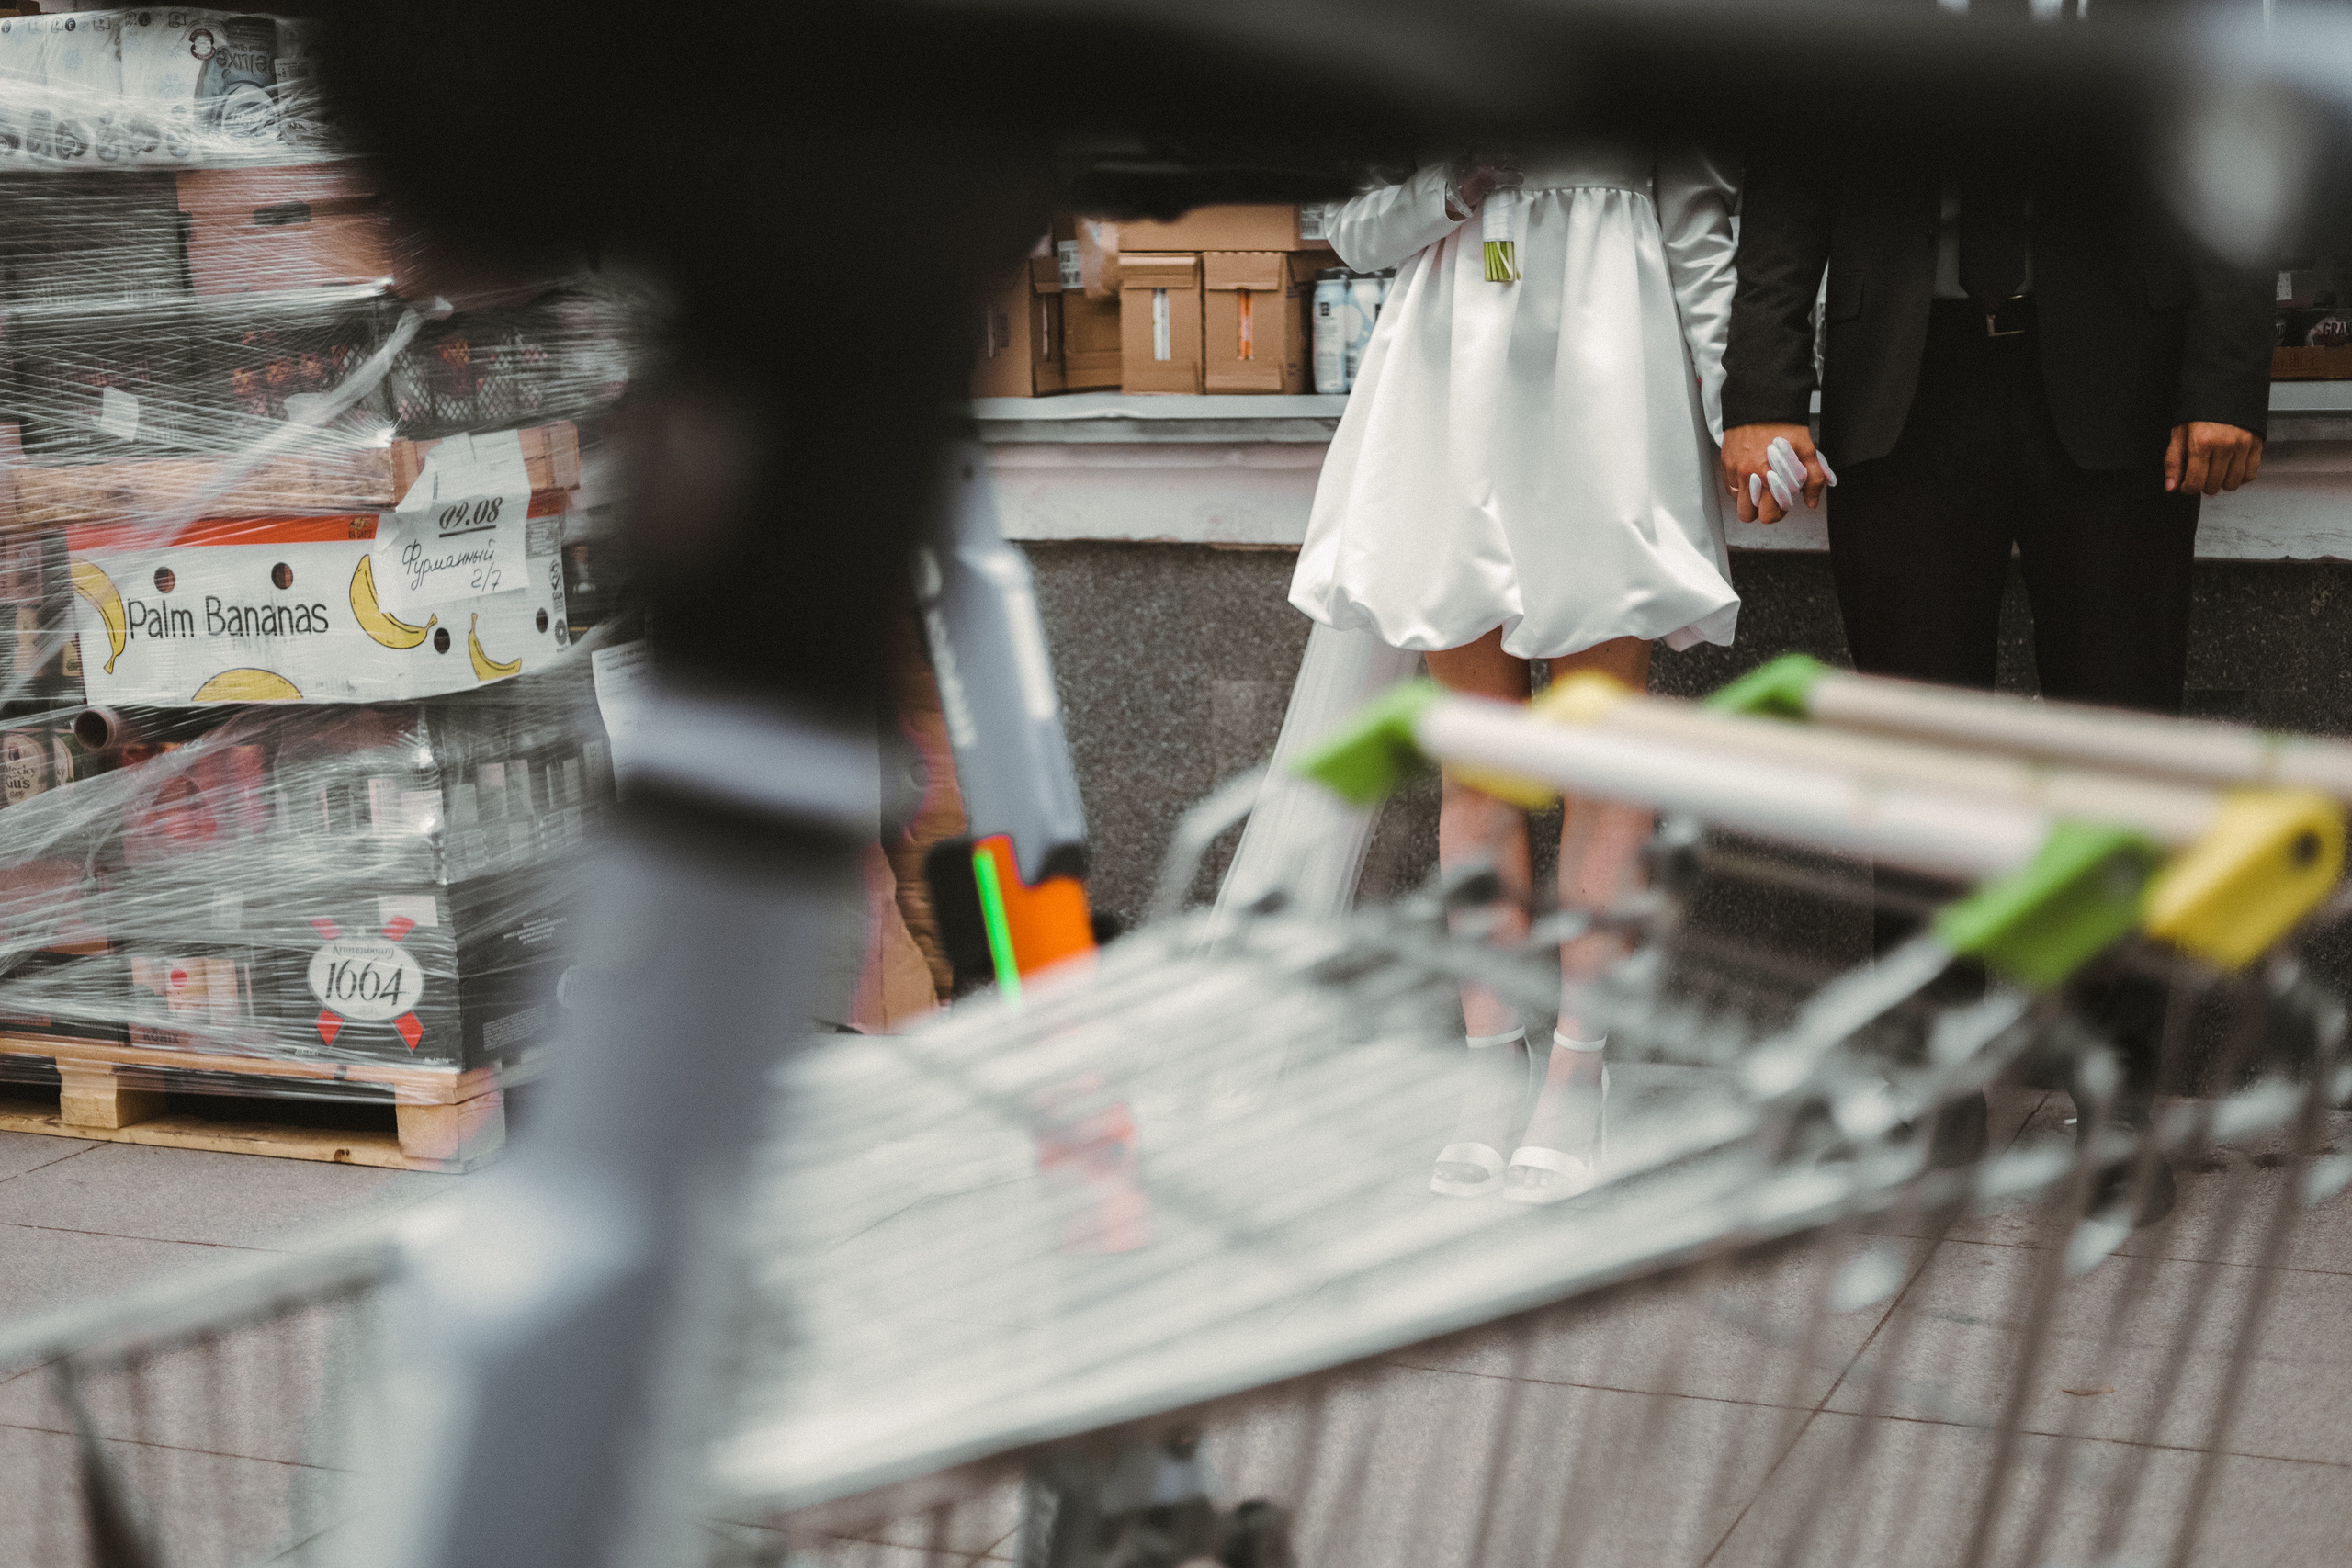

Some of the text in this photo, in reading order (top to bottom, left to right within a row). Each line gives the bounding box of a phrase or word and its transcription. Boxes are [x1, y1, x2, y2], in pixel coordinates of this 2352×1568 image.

[438, 496, 503, 530] 09.08
[470, 561, 502, 592] 2/7
[128, 594, 330, 640] Palm Bananas
[325, 957, 411, 1007] 1664
